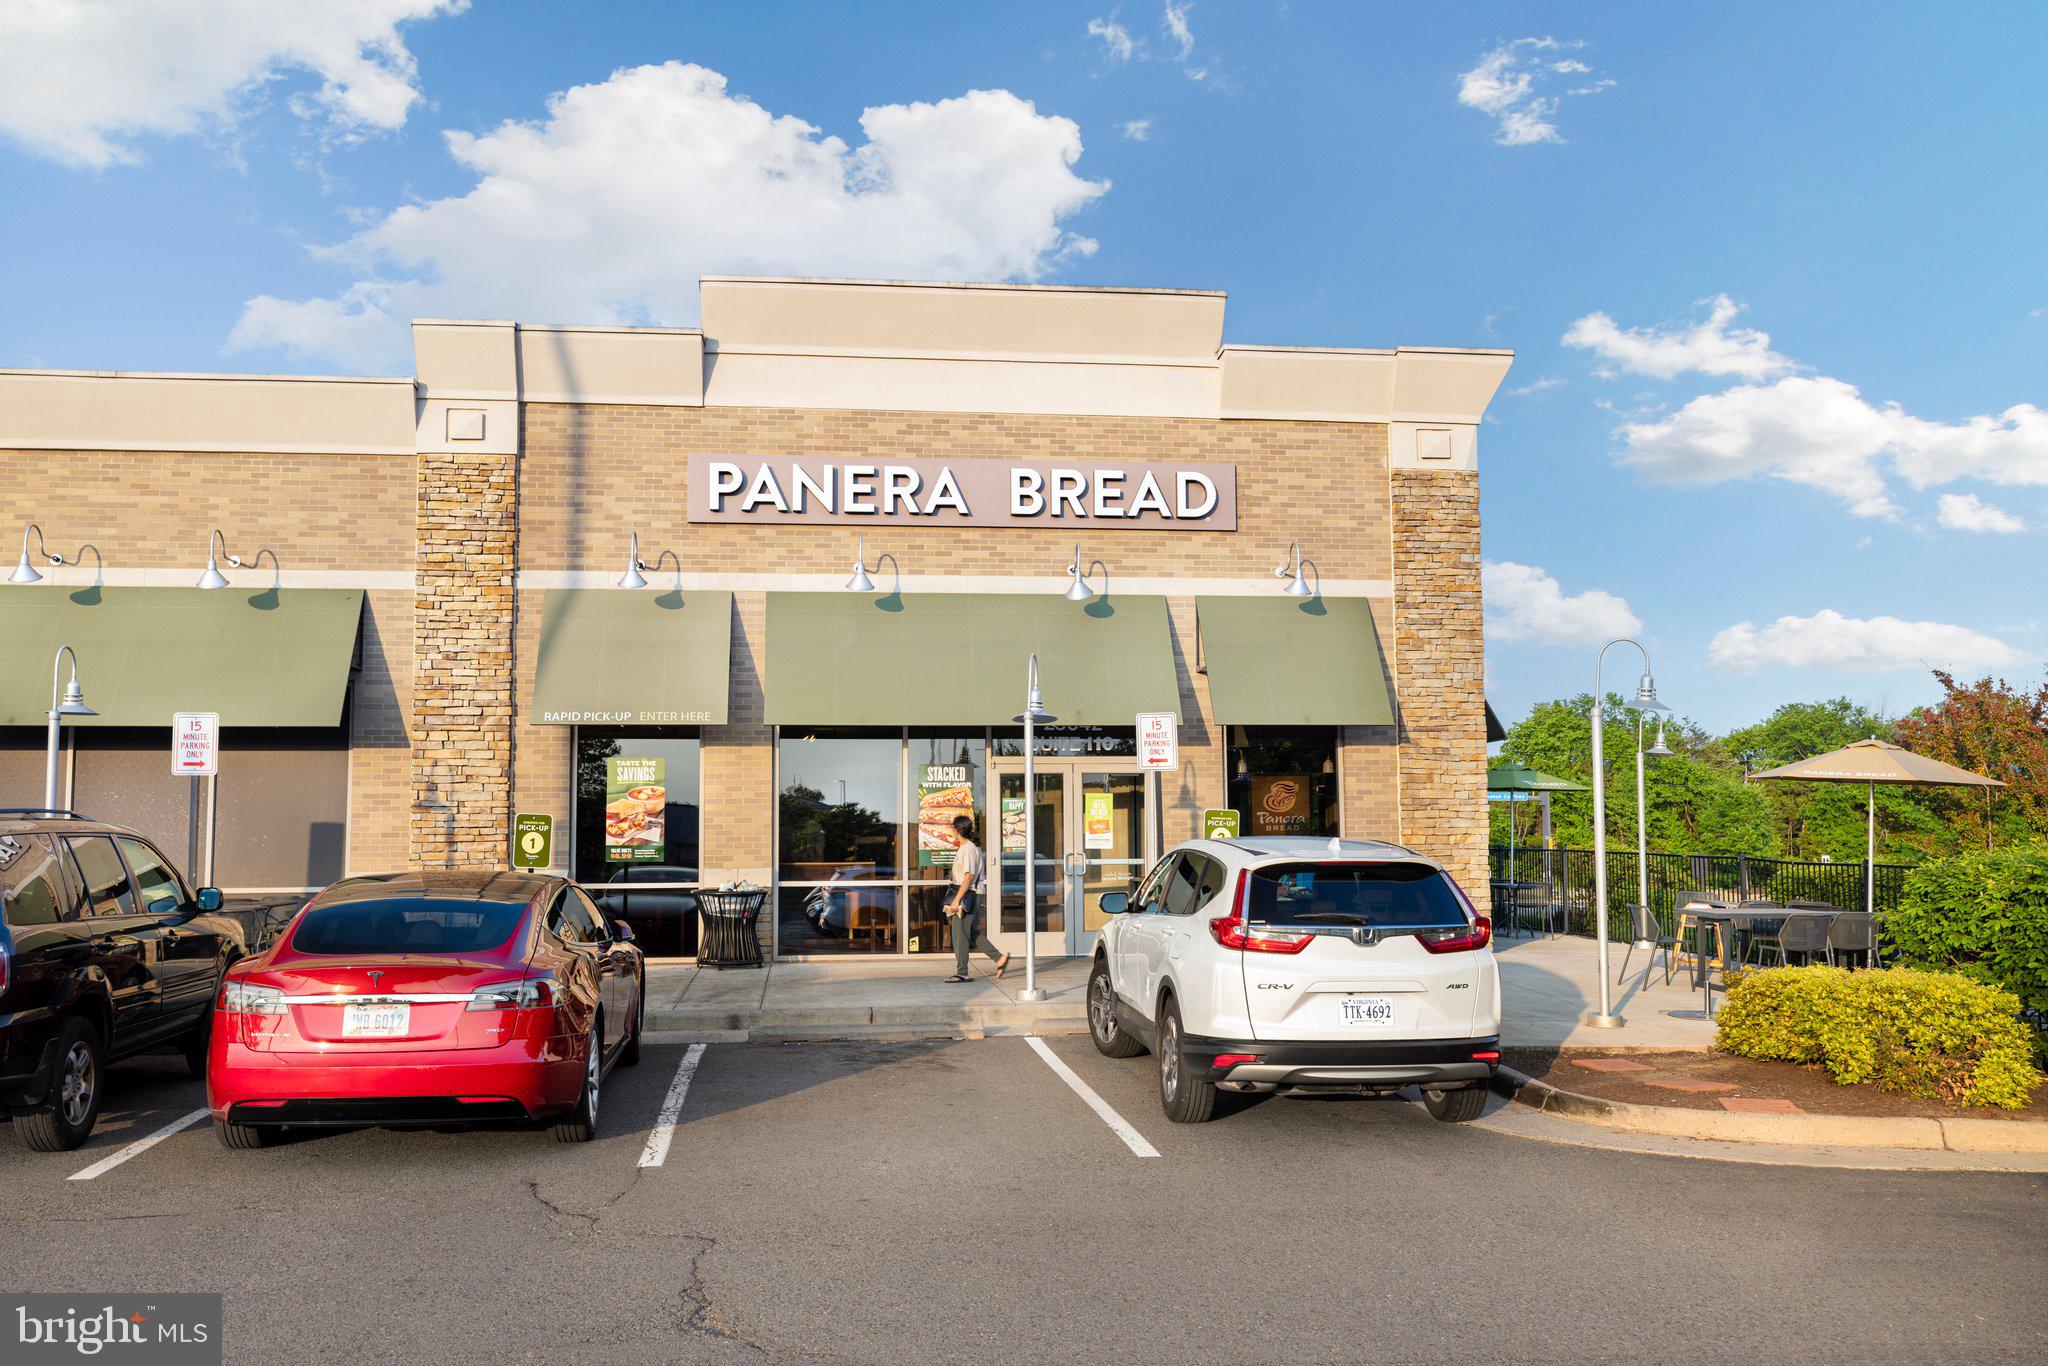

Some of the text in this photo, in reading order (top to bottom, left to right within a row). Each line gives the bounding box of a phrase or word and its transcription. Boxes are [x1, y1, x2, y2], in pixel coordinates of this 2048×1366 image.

[709, 462, 1219, 519] PANERA BREAD
[544, 712, 712, 721] RAPID PICK-UP ENTER HERE
[190, 721, 202, 731] 15
[1151, 720, 1162, 730] 15
[1087, 736, 1115, 751] 110
[617, 766, 655, 781] SAVINGS
[927, 766, 966, 781] STACKED
[1257, 811, 1306, 824] Panera
[518, 824, 549, 832] PICK-UP
[530, 837, 536, 849] 1
[1343, 1005, 1392, 1019] TTK-4692
